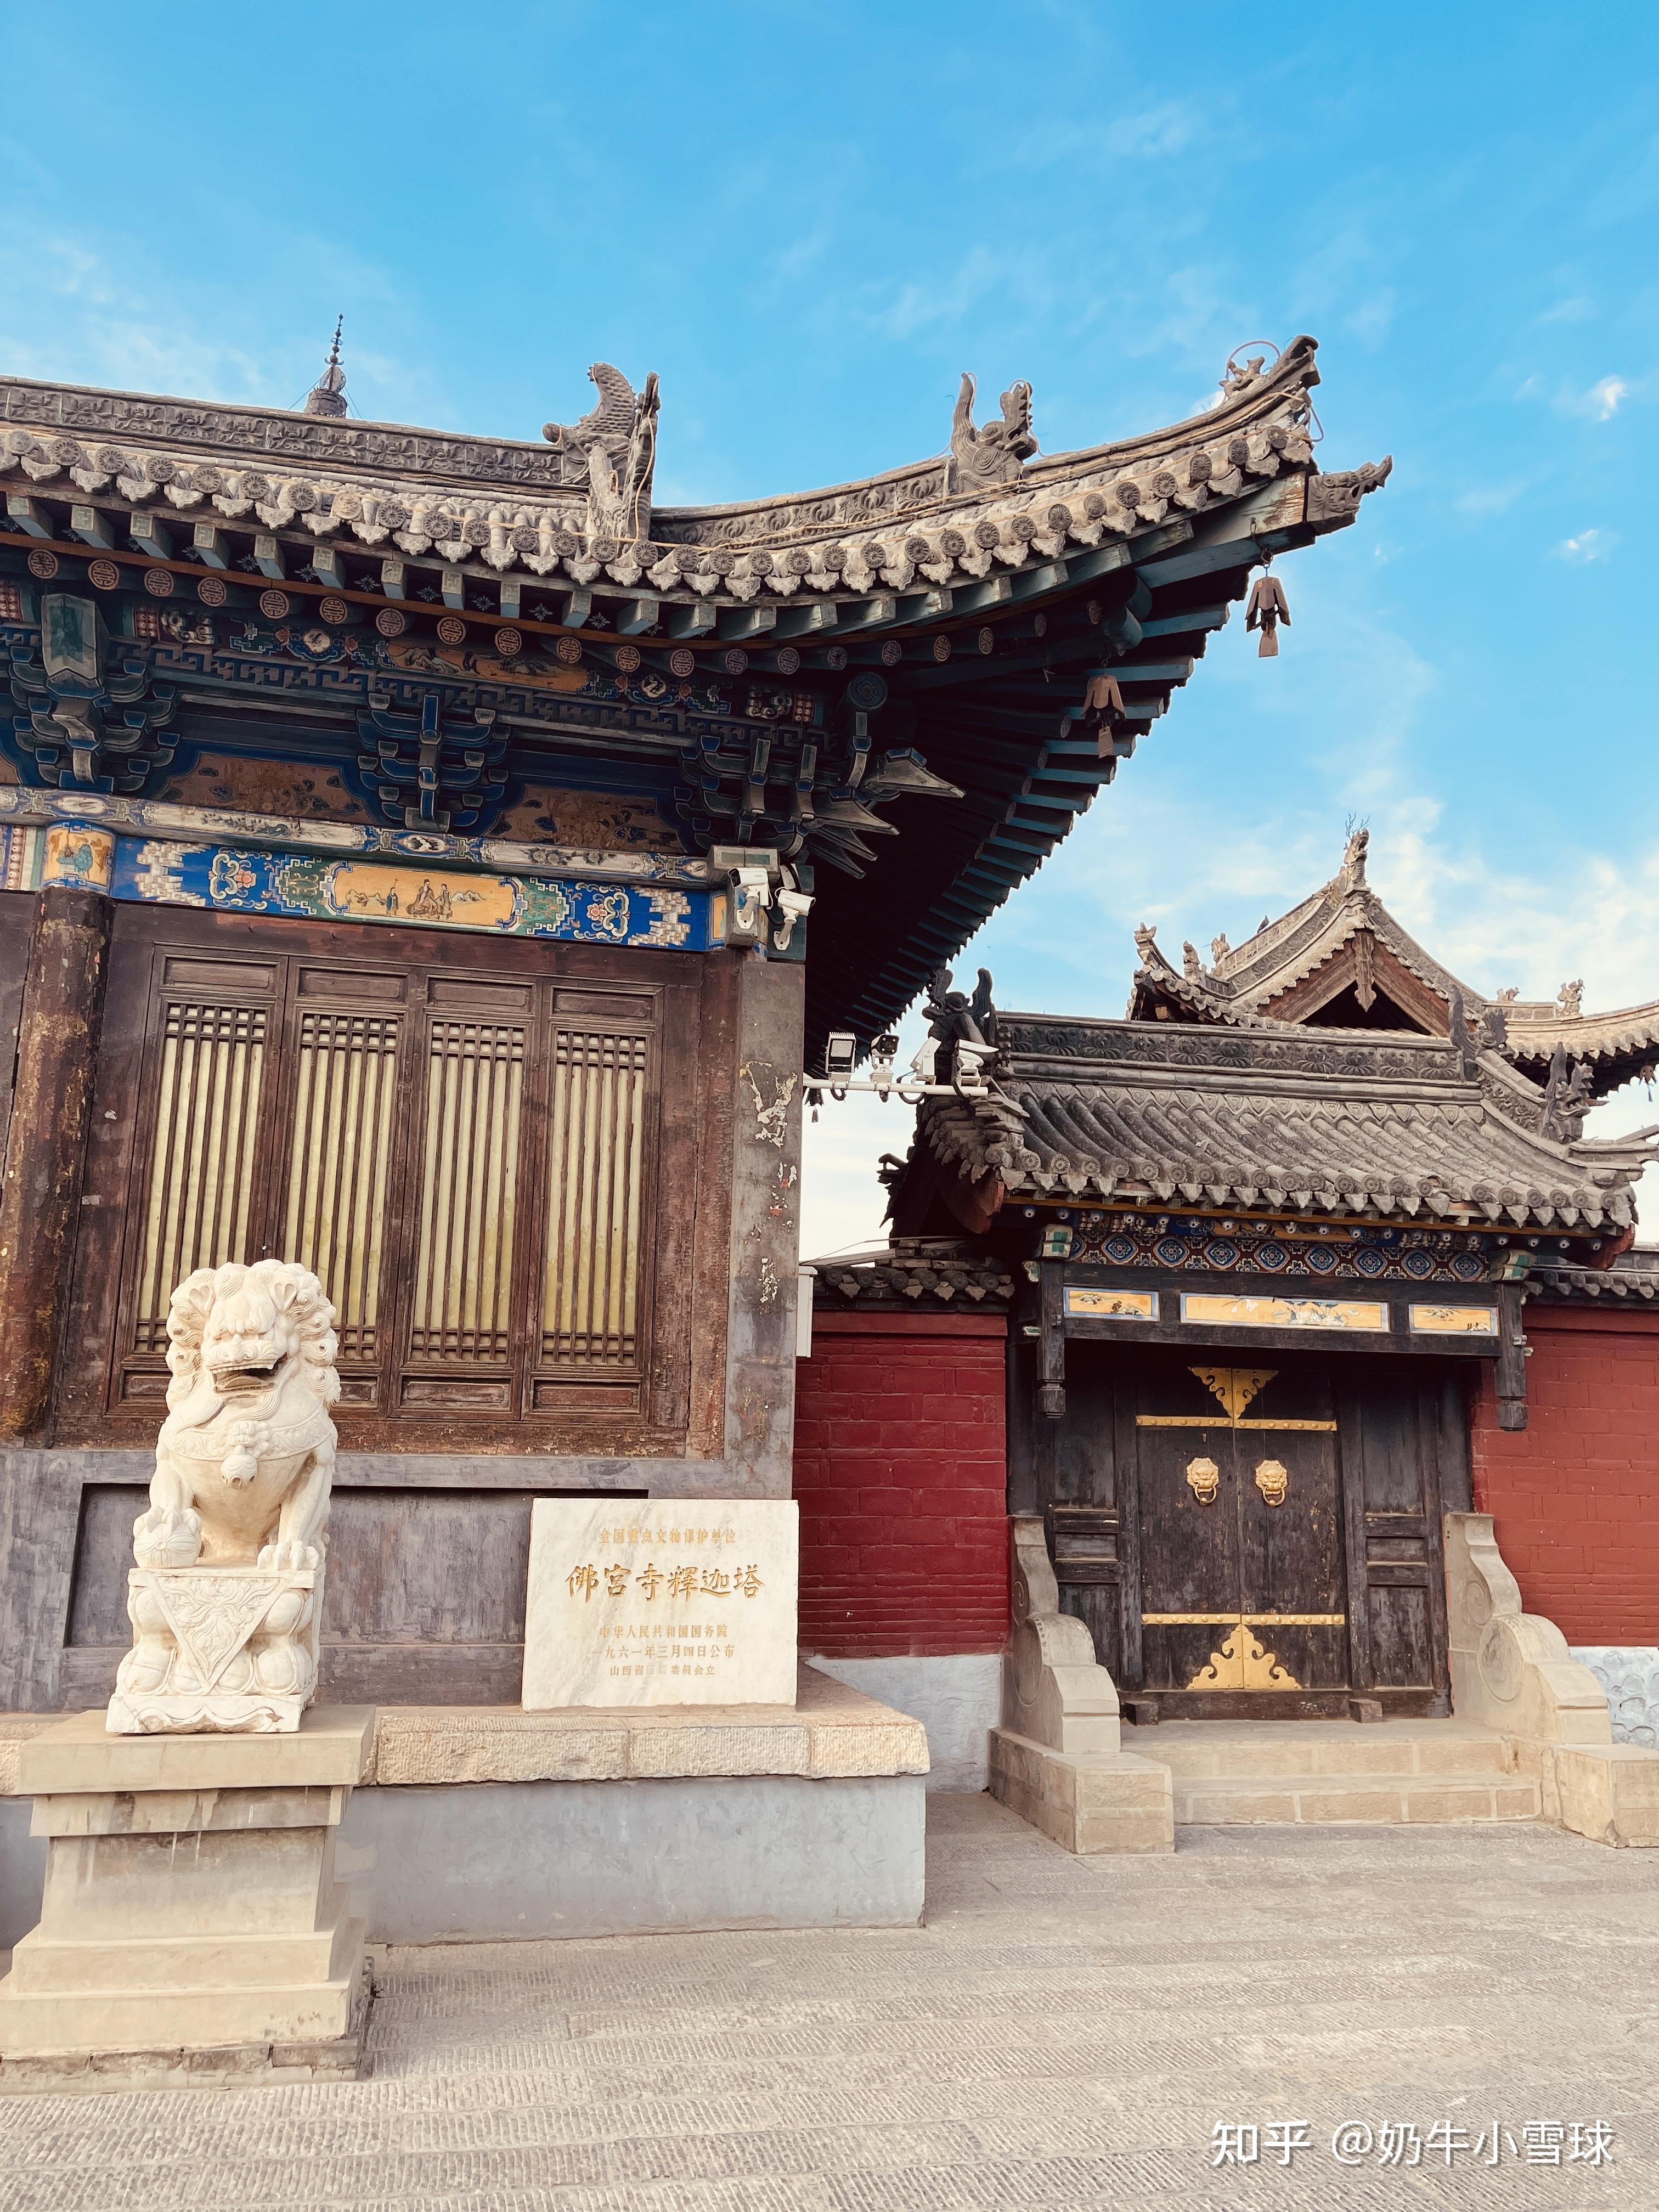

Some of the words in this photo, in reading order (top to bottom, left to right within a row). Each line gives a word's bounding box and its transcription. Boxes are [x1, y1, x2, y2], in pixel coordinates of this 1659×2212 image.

[600, 1527, 736, 1544] 全国重点文物保护单位
[600, 1624, 728, 1639] 中华人民共和国国务院
[592, 1644, 735, 1659] 一九六一年三月四日公布
[610, 1664, 715, 1677] 山西省委员会立
